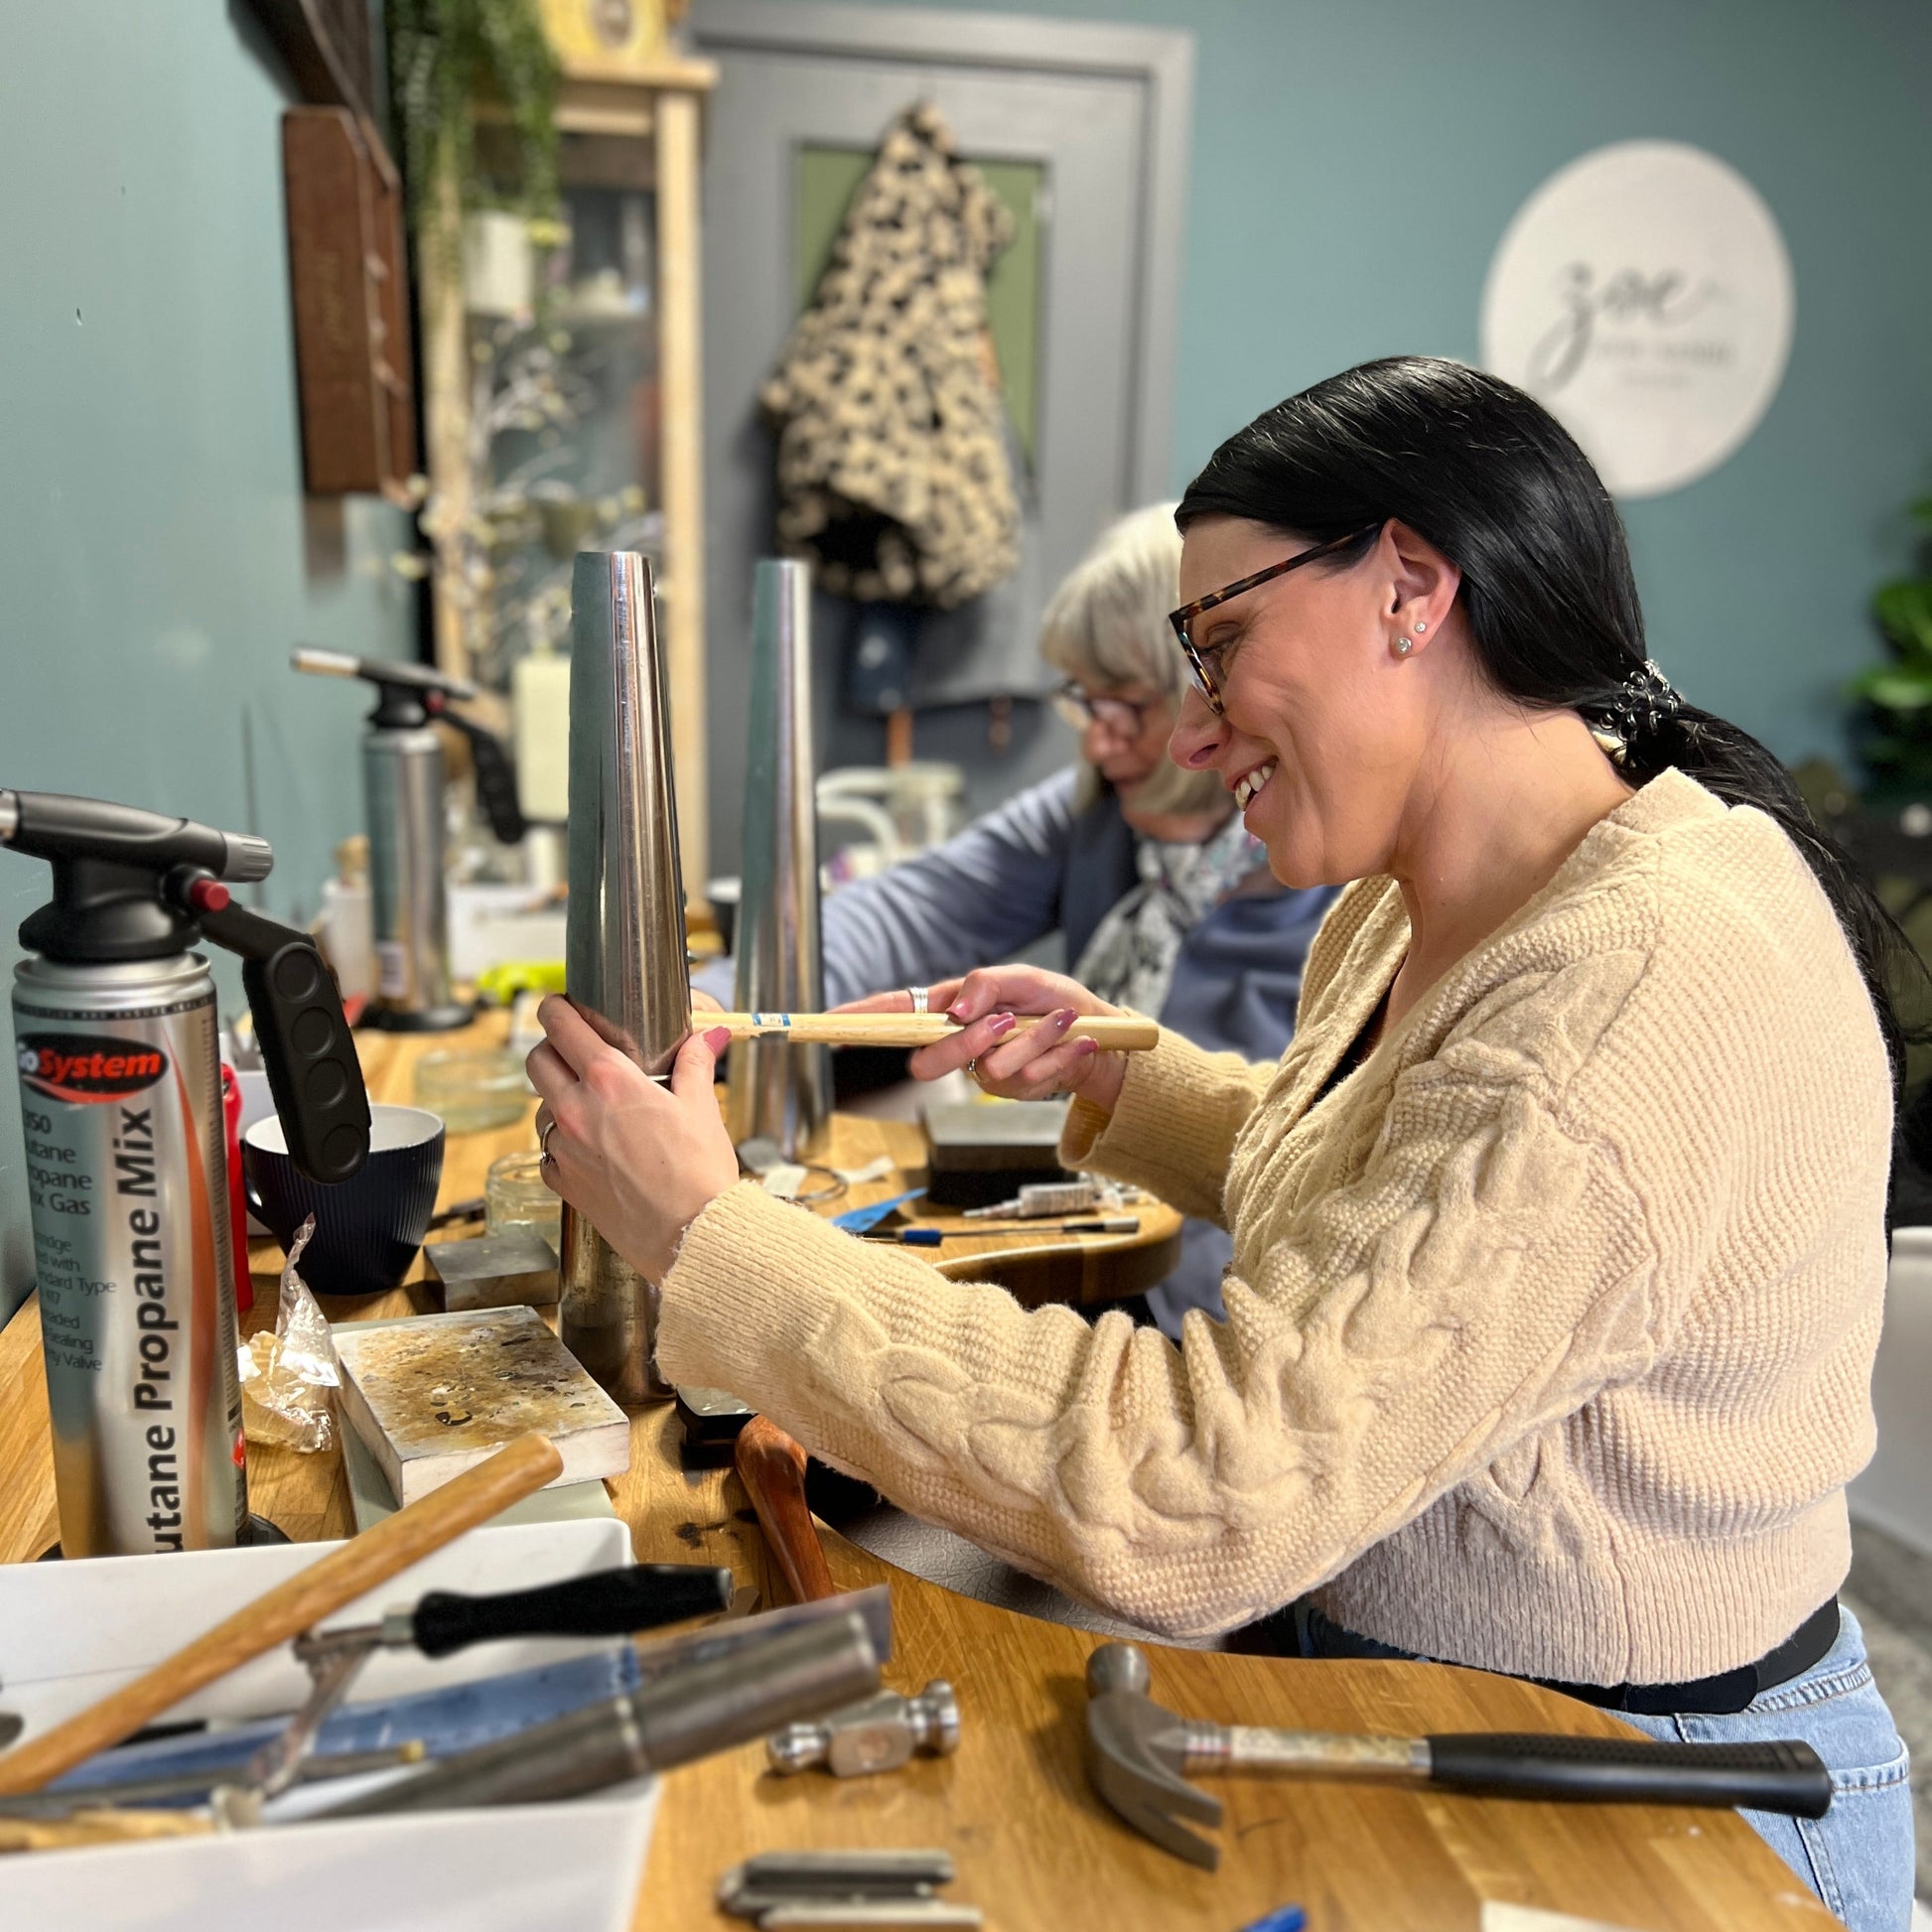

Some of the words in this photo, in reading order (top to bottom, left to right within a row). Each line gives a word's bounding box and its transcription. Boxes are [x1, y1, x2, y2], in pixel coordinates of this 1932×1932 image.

[113, 1106, 158, 1198] Mix
[50, 1192, 91, 1216] Gas
[77, 1277, 118, 1297] Type
[129, 1207, 180, 1411] Propane
[64, 1351, 103, 1371] Valve
[146, 1424, 185, 1555] utane
